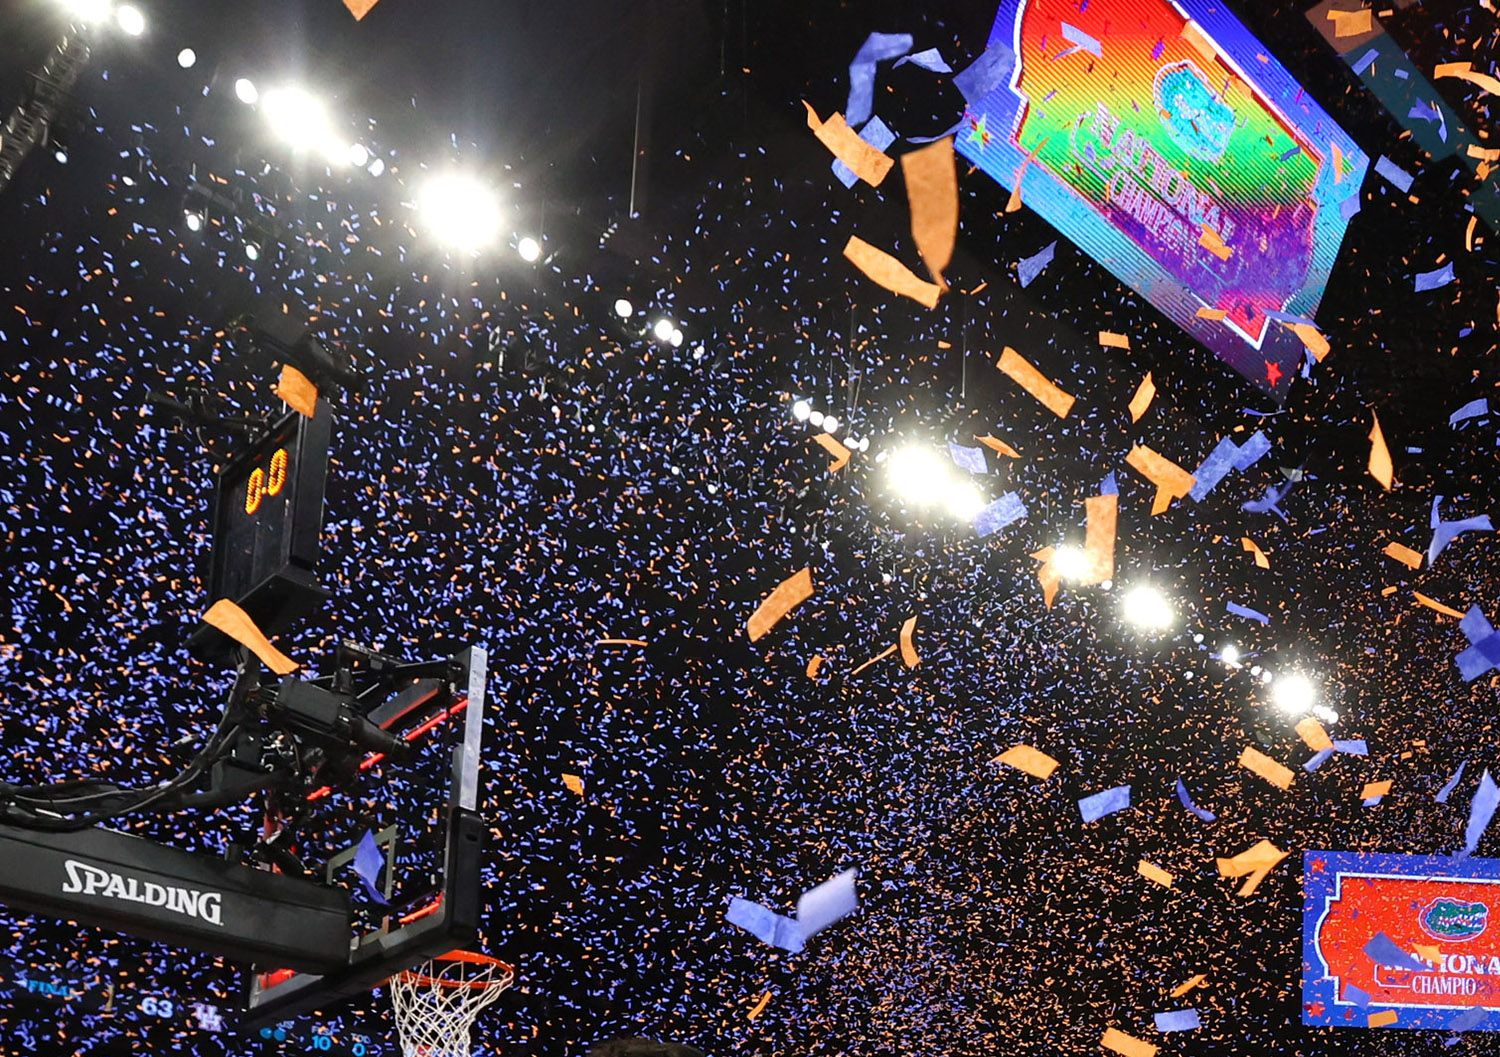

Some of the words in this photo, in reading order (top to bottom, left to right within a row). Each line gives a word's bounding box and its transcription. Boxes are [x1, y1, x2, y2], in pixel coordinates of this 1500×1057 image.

[1090, 101, 1236, 244] NATIONAL
[245, 448, 289, 515] 0.0
[62, 859, 223, 926] SPALDING
[141, 997, 174, 1018] 63
[312, 1035, 332, 1051] 10
